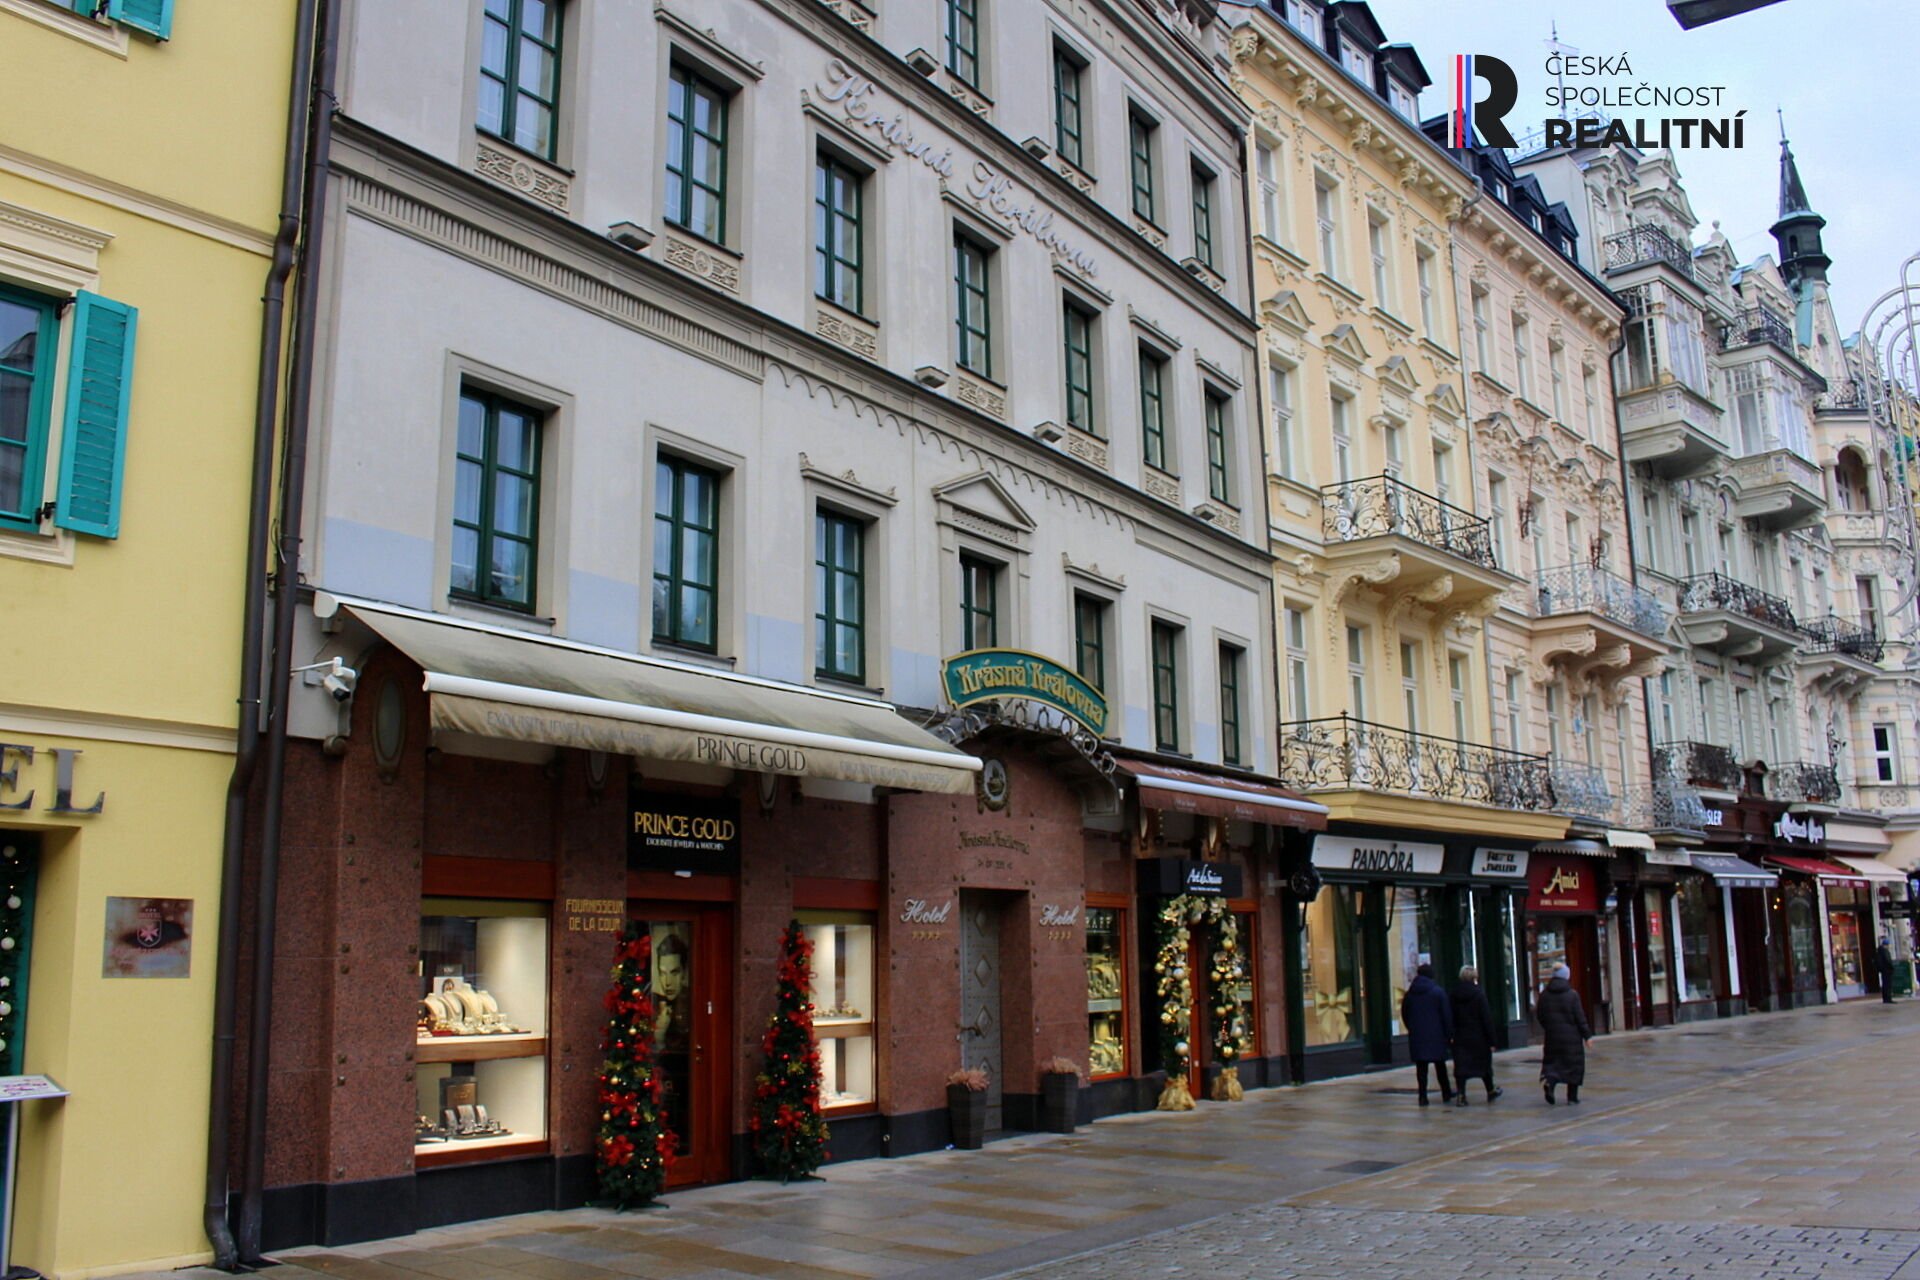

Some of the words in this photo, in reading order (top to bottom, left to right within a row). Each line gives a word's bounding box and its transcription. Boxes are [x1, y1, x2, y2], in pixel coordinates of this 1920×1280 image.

[957, 659, 1027, 695] Krásná
[1030, 662, 1104, 727] Královna
[697, 736, 757, 767] PRINCE
[760, 745, 807, 772] GOLD
[634, 811, 689, 837] PRINCE
[692, 818, 735, 841] GOLD
[1351, 846, 1414, 872] PANDORA
[1542, 866, 1580, 895] Amici
[569, 917, 581, 931] DE
[583, 917, 595, 931] LA
[900, 898, 951, 924] Hotel
[1040, 904, 1080, 926] Hotel
